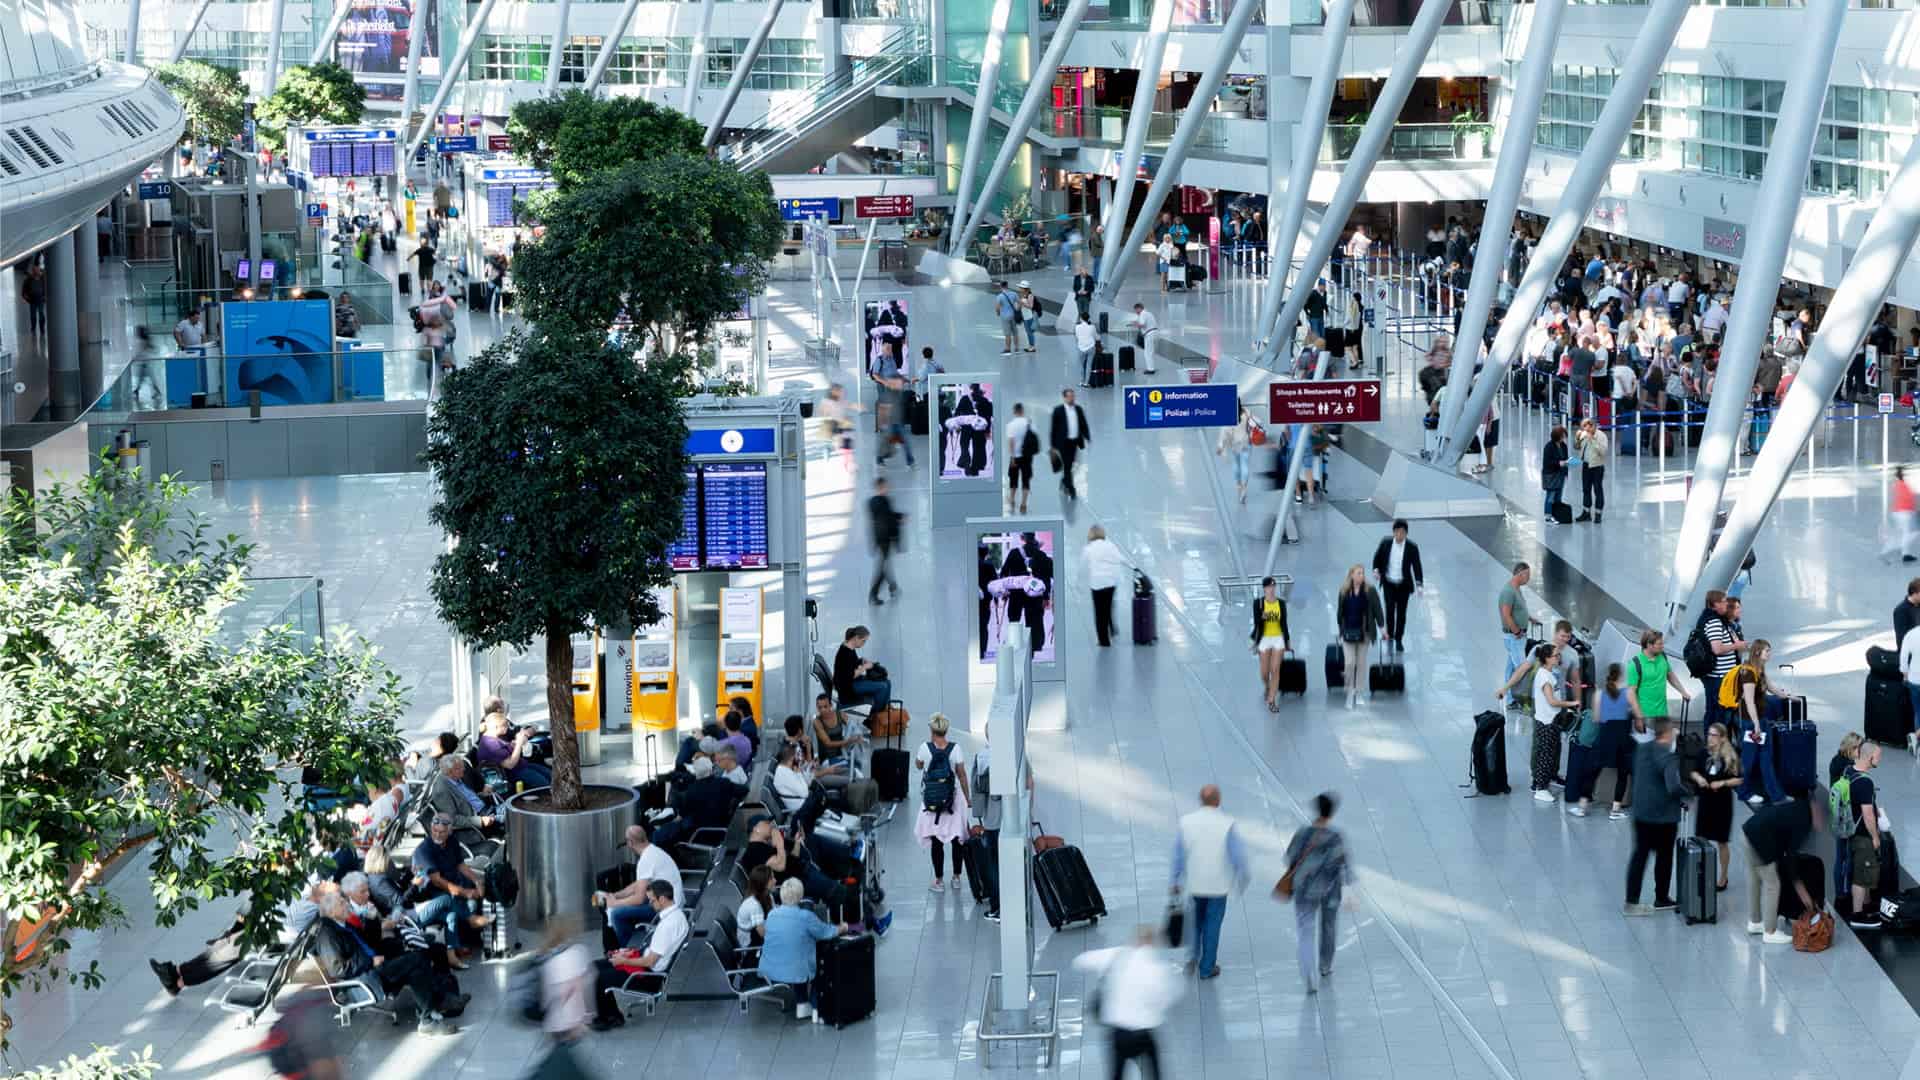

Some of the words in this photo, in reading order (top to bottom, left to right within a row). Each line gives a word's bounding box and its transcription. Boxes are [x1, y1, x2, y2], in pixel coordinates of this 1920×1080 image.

[158, 185, 171, 195] 10
[310, 205, 318, 216] P
[1164, 392, 1209, 400] Information
[1165, 408, 1190, 417] Polizei
[1194, 408, 1217, 416] Police
[623, 657, 633, 714] Eurowings
